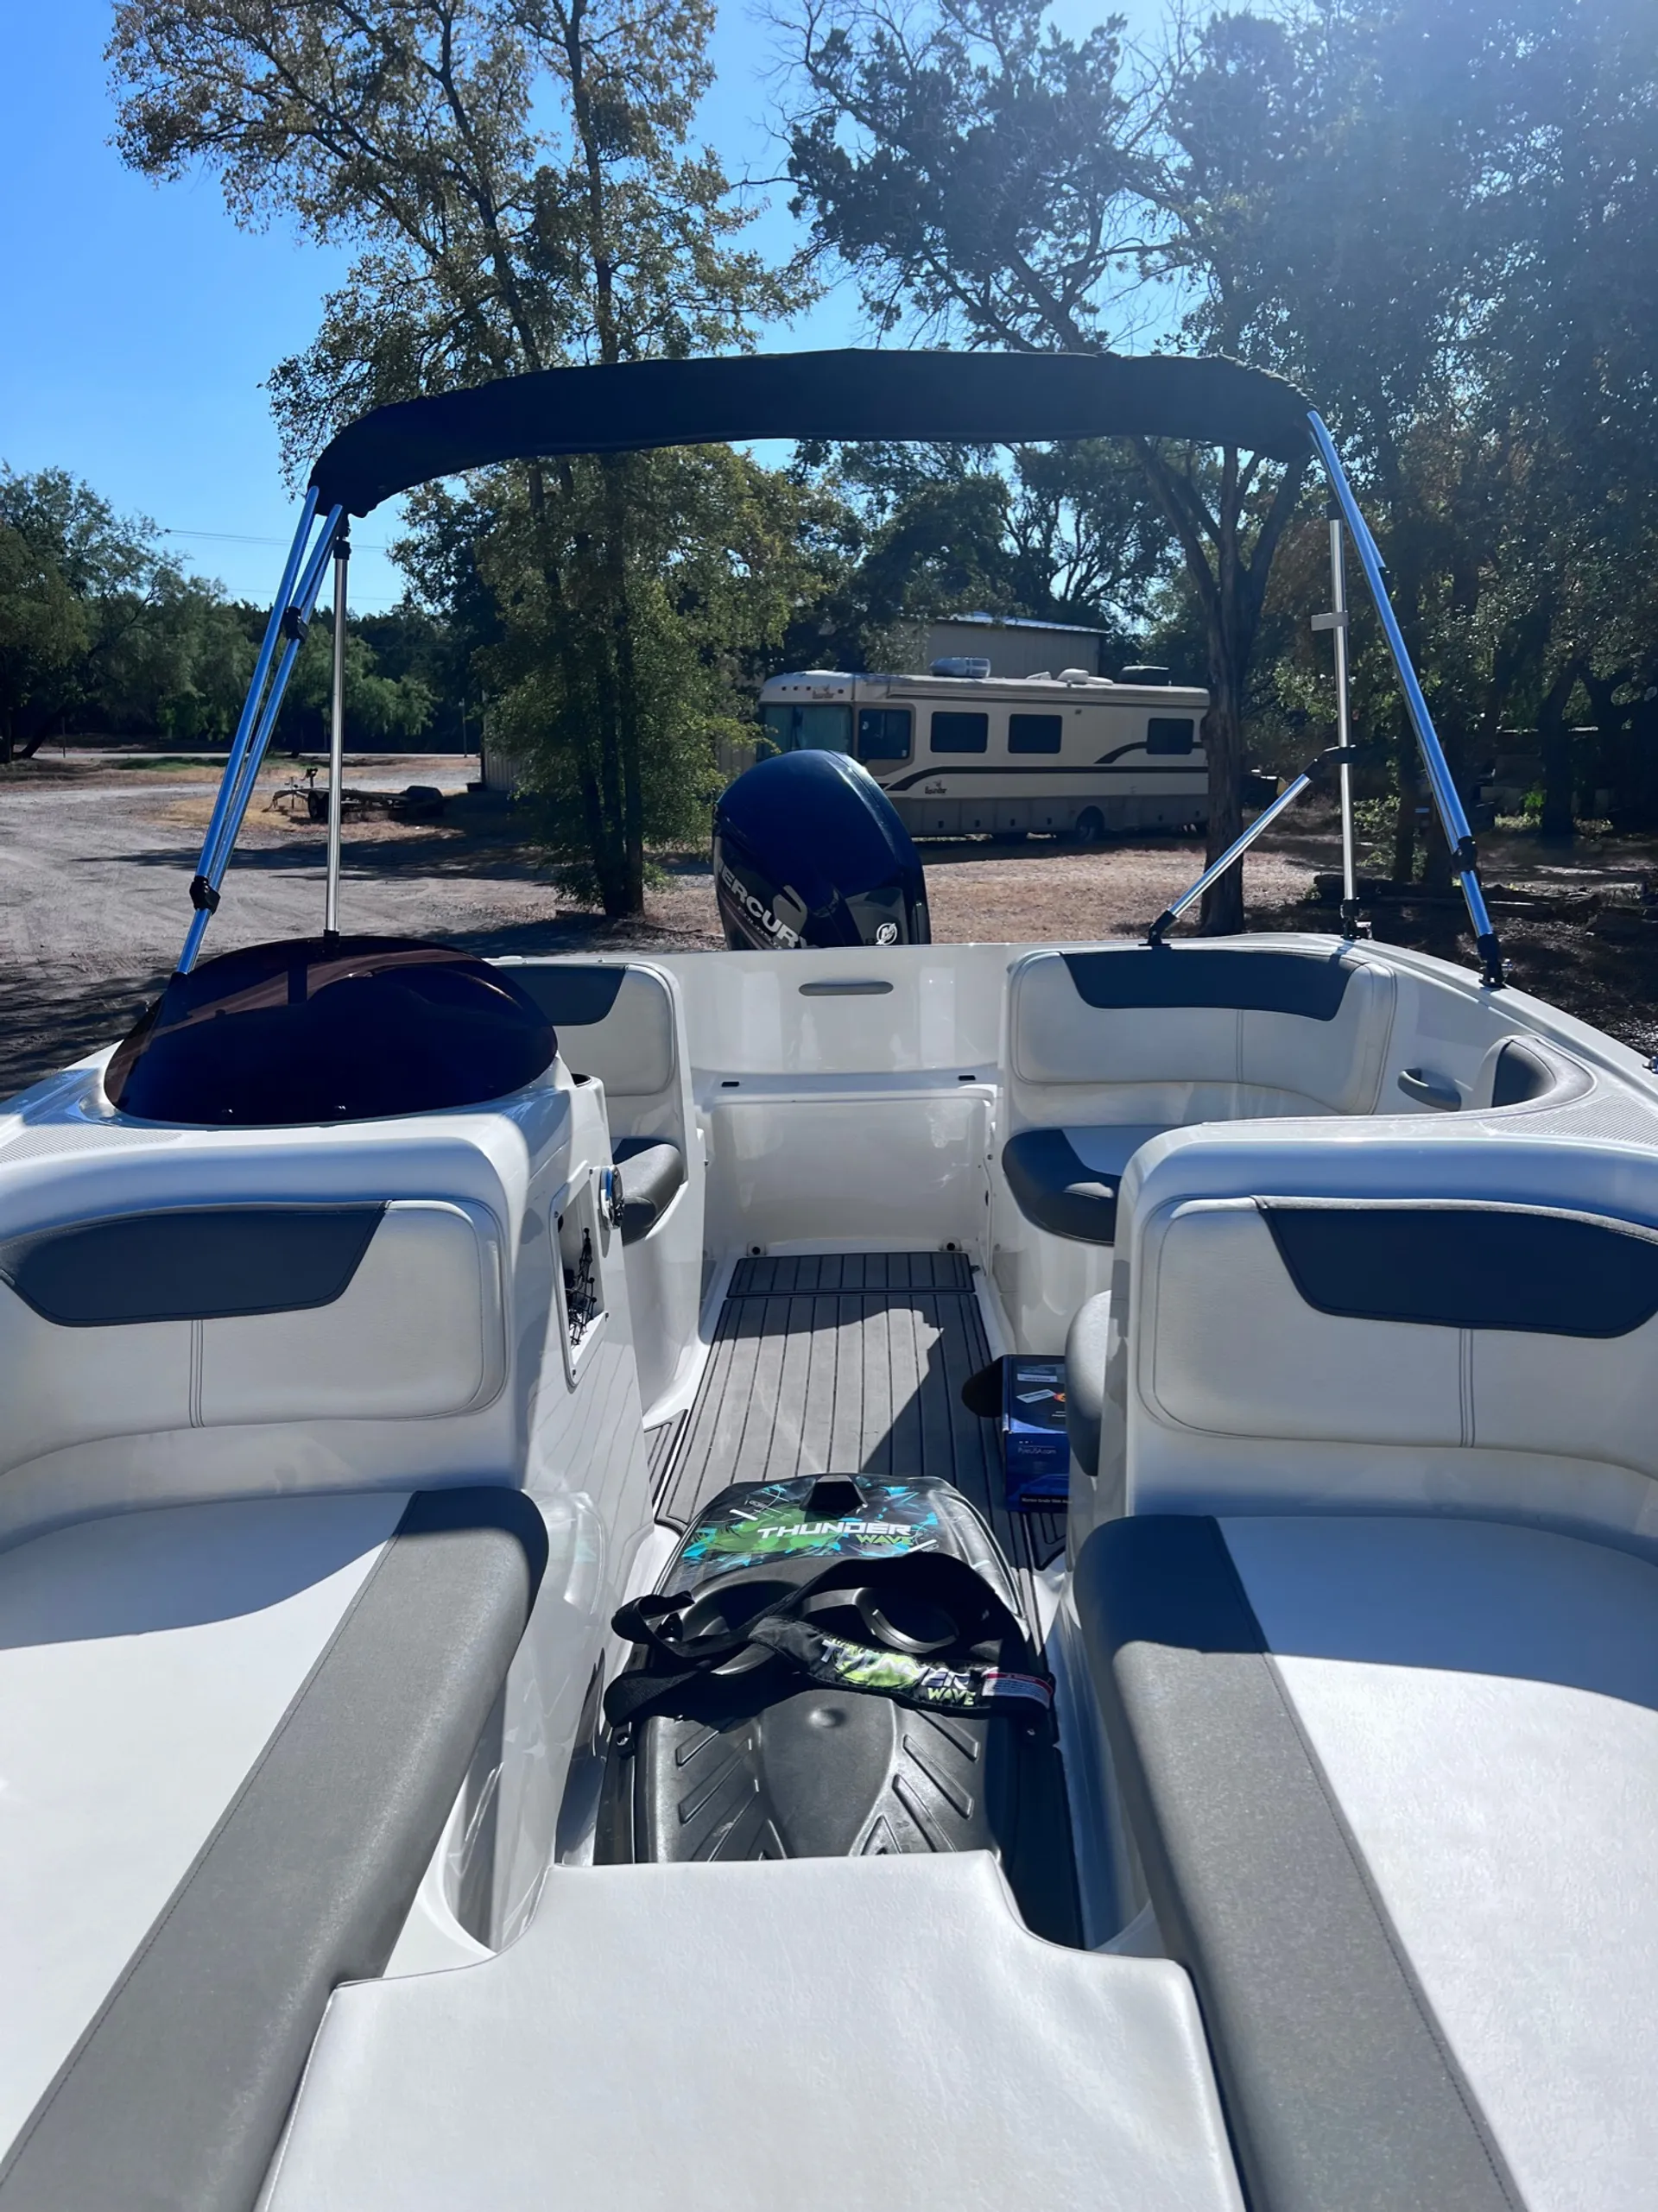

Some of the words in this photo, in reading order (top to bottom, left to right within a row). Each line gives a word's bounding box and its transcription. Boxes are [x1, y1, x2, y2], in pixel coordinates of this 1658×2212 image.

[757, 1522, 912, 1539] THUNDER
[856, 1534, 914, 1546] WAVE
[927, 1687, 977, 1706] WAVE
